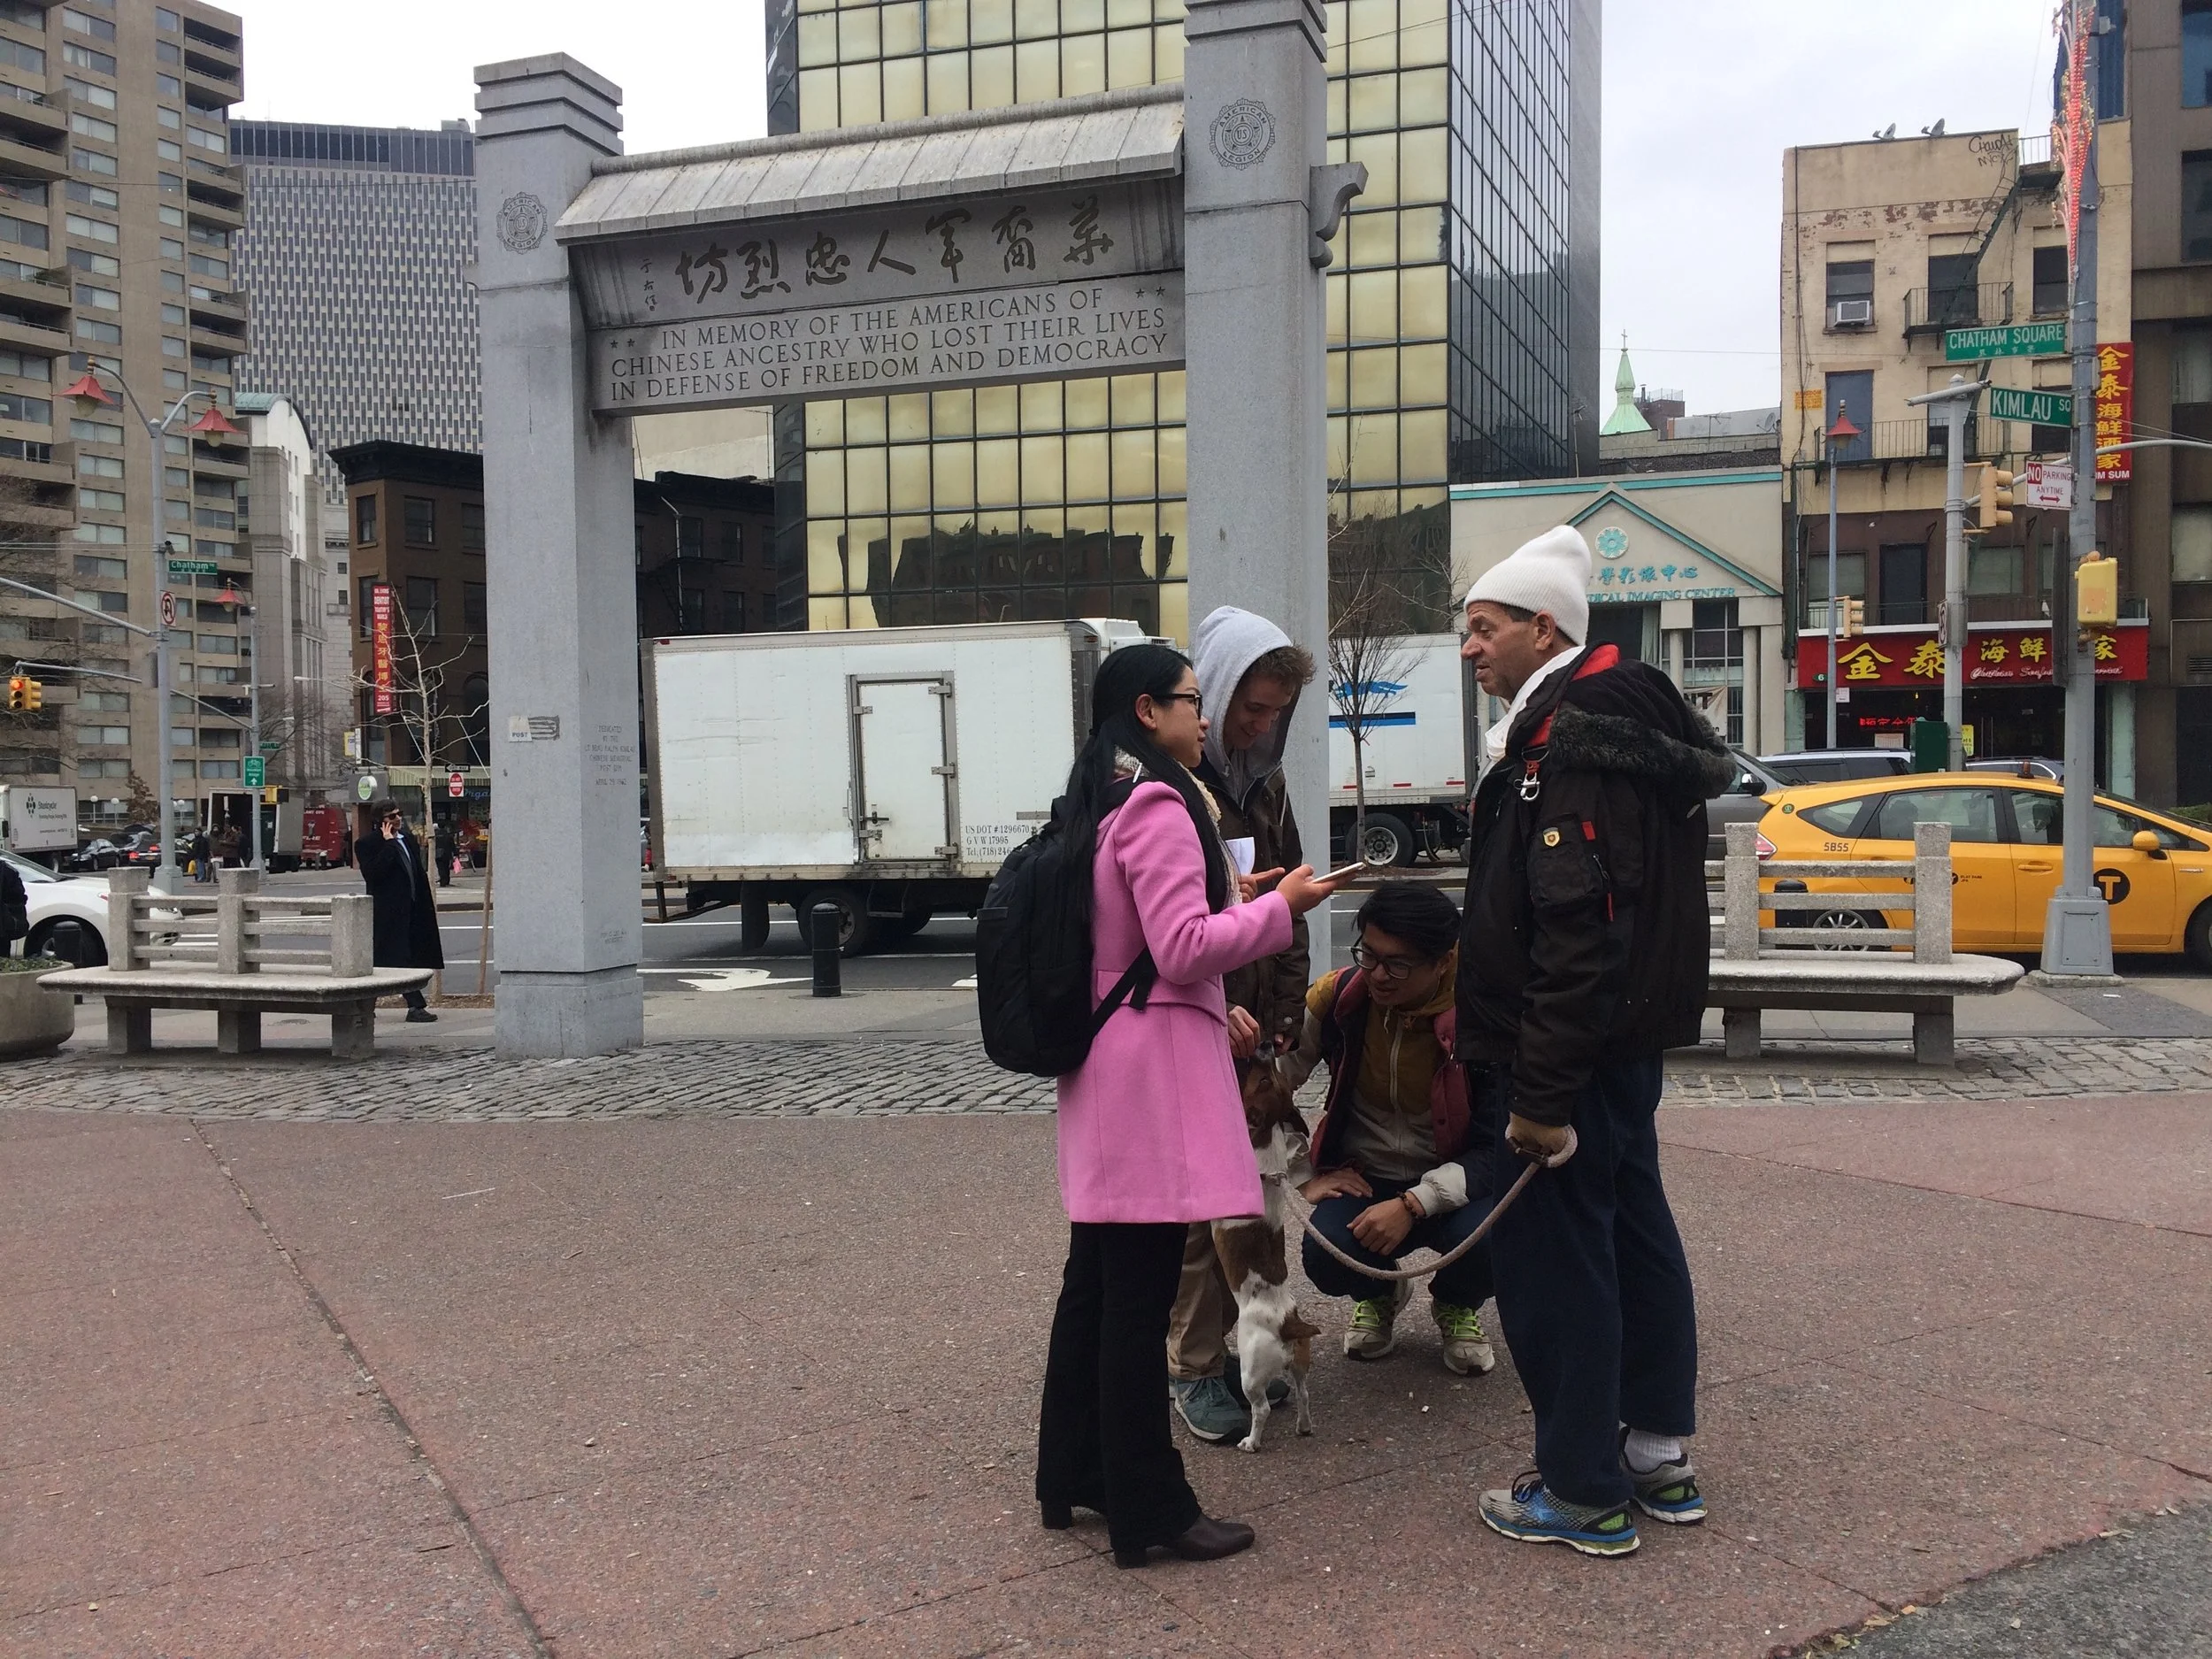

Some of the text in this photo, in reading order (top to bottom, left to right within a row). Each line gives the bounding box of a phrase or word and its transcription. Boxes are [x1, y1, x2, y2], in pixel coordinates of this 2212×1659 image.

[1219, 106, 1267, 127] AMERICAN
[1236, 129, 1248, 140] US
[1223, 149, 1261, 163] LEGION
[663, 288, 1103, 349] IN MEMORY OF THE AMERICANS OF
[611, 307, 1164, 378] CHINESE ANCESTRY WHO LOST THEIR LIVES
[1949, 325, 2065, 349] CHATHAM SQUARE
[611, 333, 1168, 401] IN DEFENSE OF FREEDOM AND DEMOCRACY
[1992, 389, 2070, 421] KIMLAU SQ
[2028, 465, 2071, 481] NO PARKING
[2108, 470, 2131, 479] SUM
[2036, 486, 2064, 495] ANYTIME
[1626, 589, 1681, 602] IMAGING
[1685, 588, 1736, 599] CENTER
[965, 825, 975, 833] US
[976, 825, 992, 833] DOT
[1001, 825, 1030, 833] 1296670
[988, 836, 1009, 845] 17995
[2098, 876, 2121, 900] T
